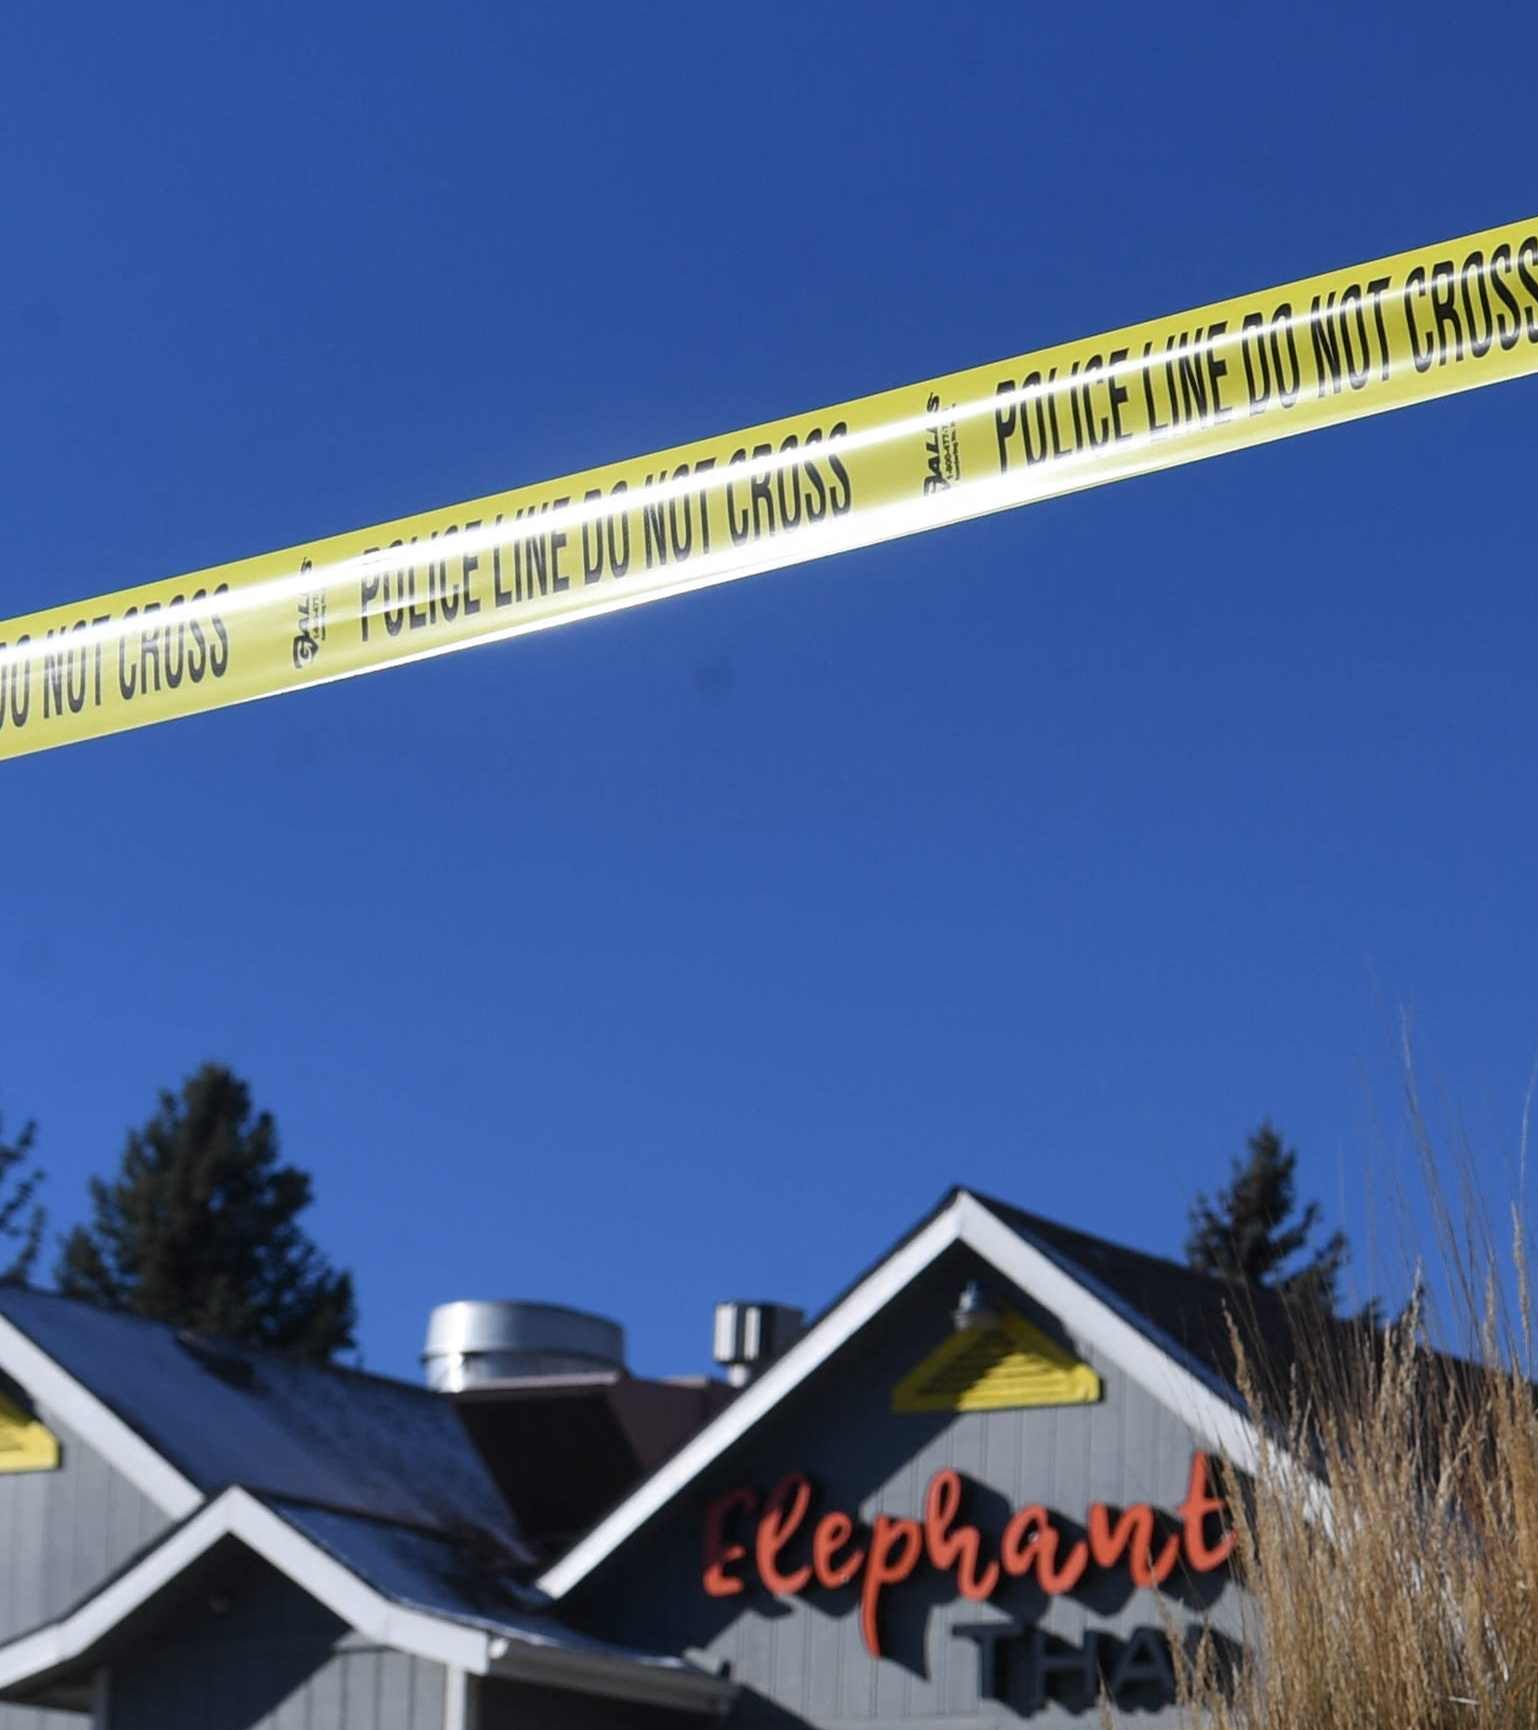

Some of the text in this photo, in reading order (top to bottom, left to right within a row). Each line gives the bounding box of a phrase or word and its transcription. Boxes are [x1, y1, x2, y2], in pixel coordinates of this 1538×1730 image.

[996, 348, 1132, 474] POLICE
[1143, 321, 1232, 438] LINE
[1242, 303, 1300, 416] DO
[1310, 276, 1392, 398] NOT
[361, 520, 482, 642] POLICE
[494, 496, 571, 608] LINE
[582, 481, 630, 585] DO
[644, 456, 717, 569] NOT
[726, 422, 851, 548] CROSS
[43, 614, 111, 719] NOT
[119, 583, 230, 700] CROSS
[703, 1451, 1237, 1658] Elephant
